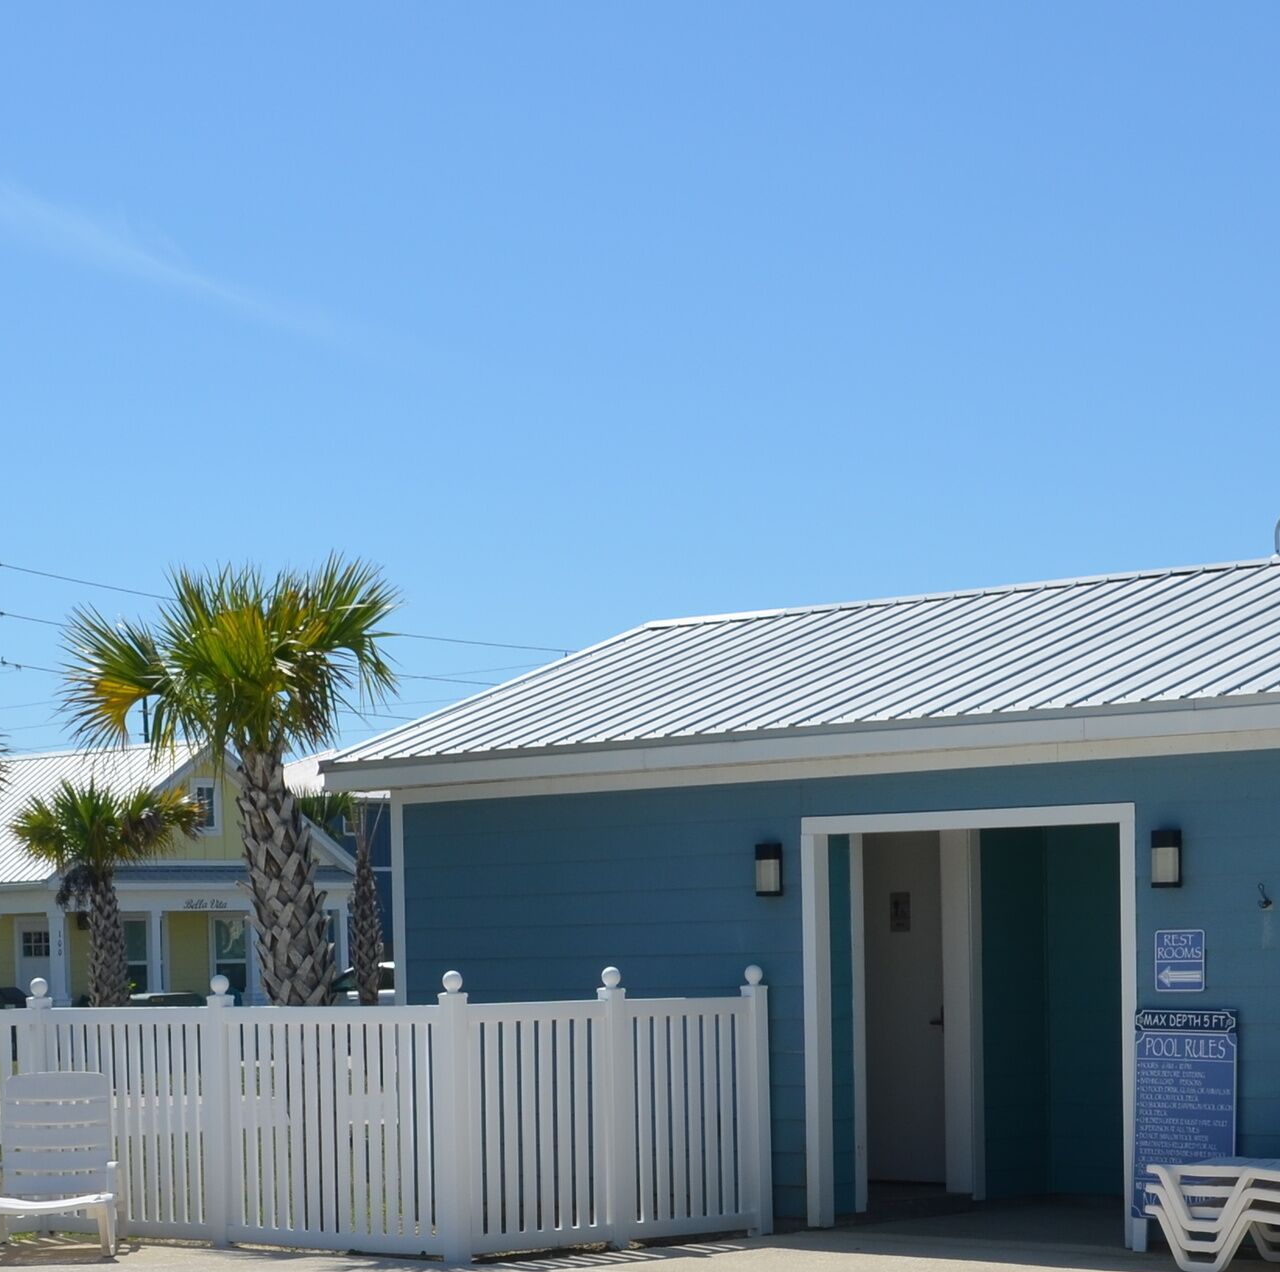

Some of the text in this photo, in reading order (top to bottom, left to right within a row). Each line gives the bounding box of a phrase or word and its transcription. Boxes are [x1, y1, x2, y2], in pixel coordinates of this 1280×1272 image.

[1163, 934, 1195, 946] REST
[1157, 946, 1202, 959] ROOMS
[1143, 1014, 1226, 1028] MAX DEPTH 5 FT
[1145, 1037, 1226, 1059] POOL RULES
